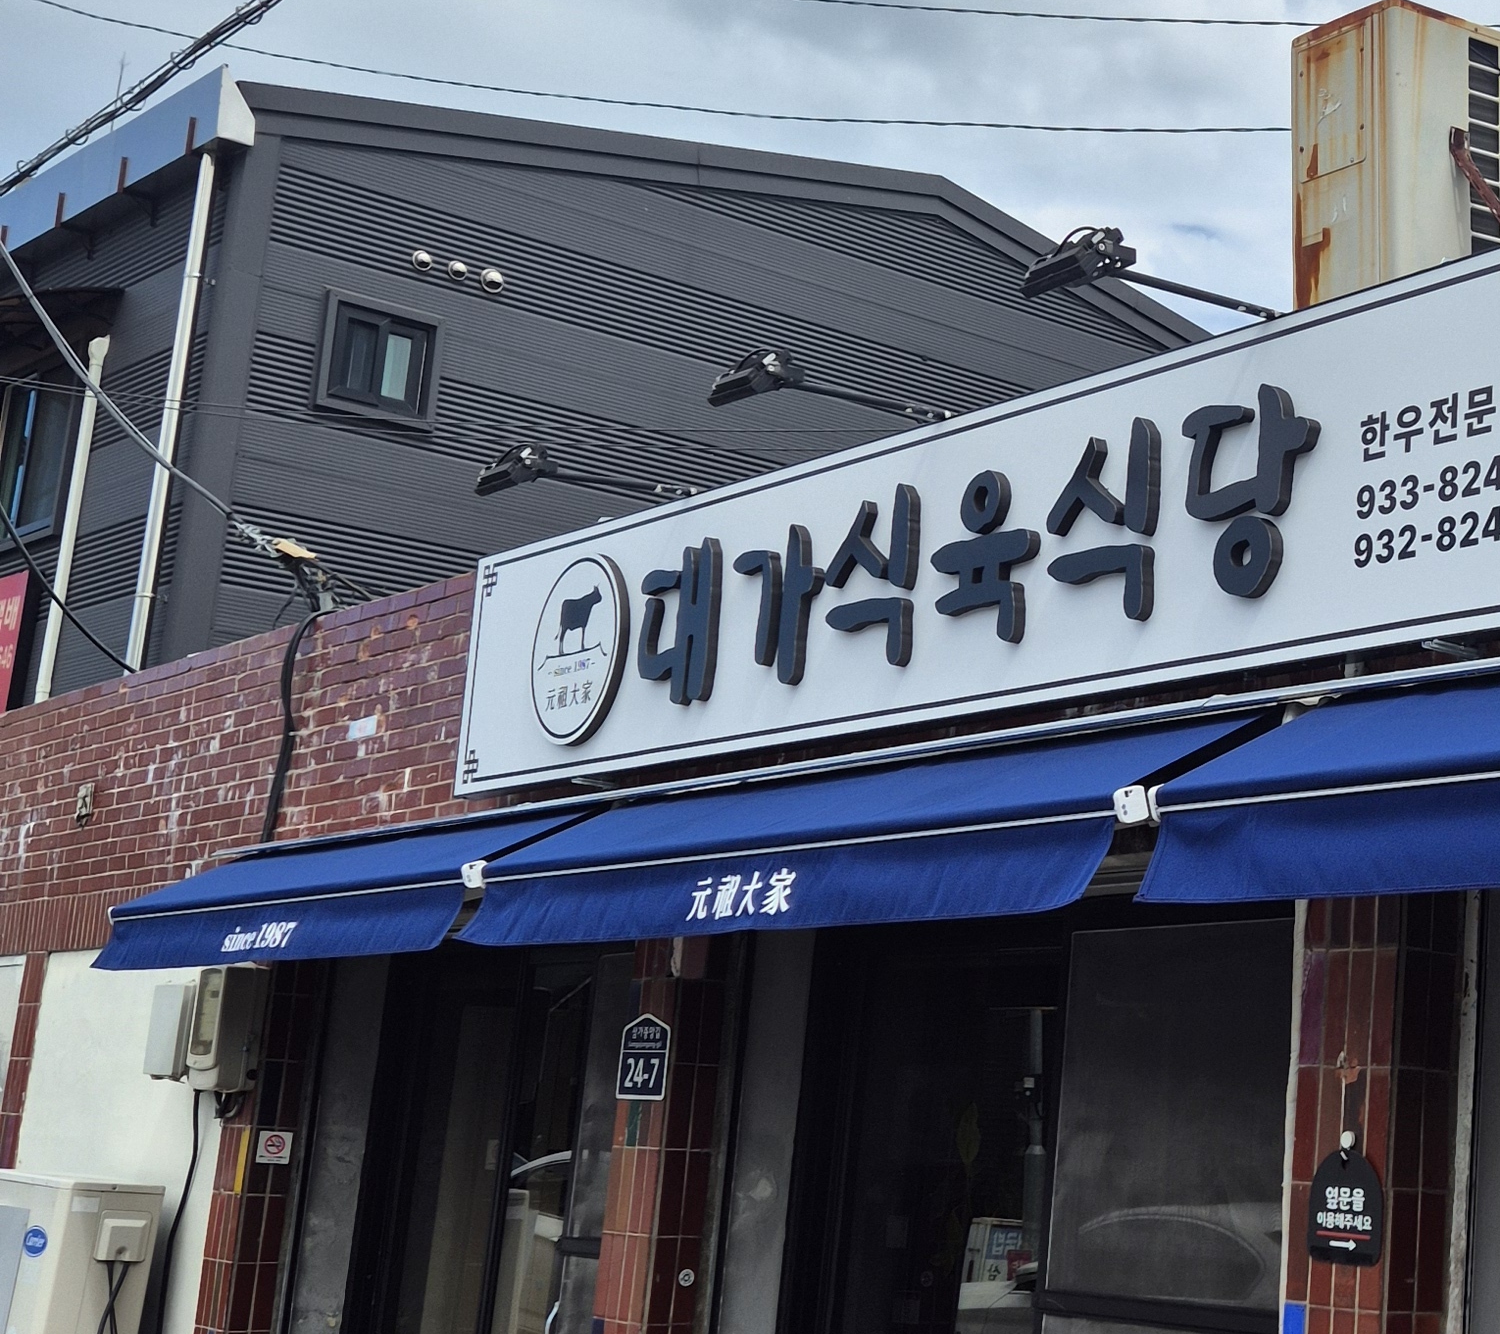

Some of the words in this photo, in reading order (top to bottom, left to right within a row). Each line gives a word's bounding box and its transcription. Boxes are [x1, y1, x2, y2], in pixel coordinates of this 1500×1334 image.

[637, 383, 1321, 707] 대가식육식당
[686, 867, 797, 921] 元祖大家
[220, 926, 257, 952] since
[253, 921, 299, 949] 1987
[624, 1057, 660, 1088] 24-7
[1325, 1186, 1366, 1212] 옆문을
[1316, 1211, 1373, 1232] 이용해주세요
